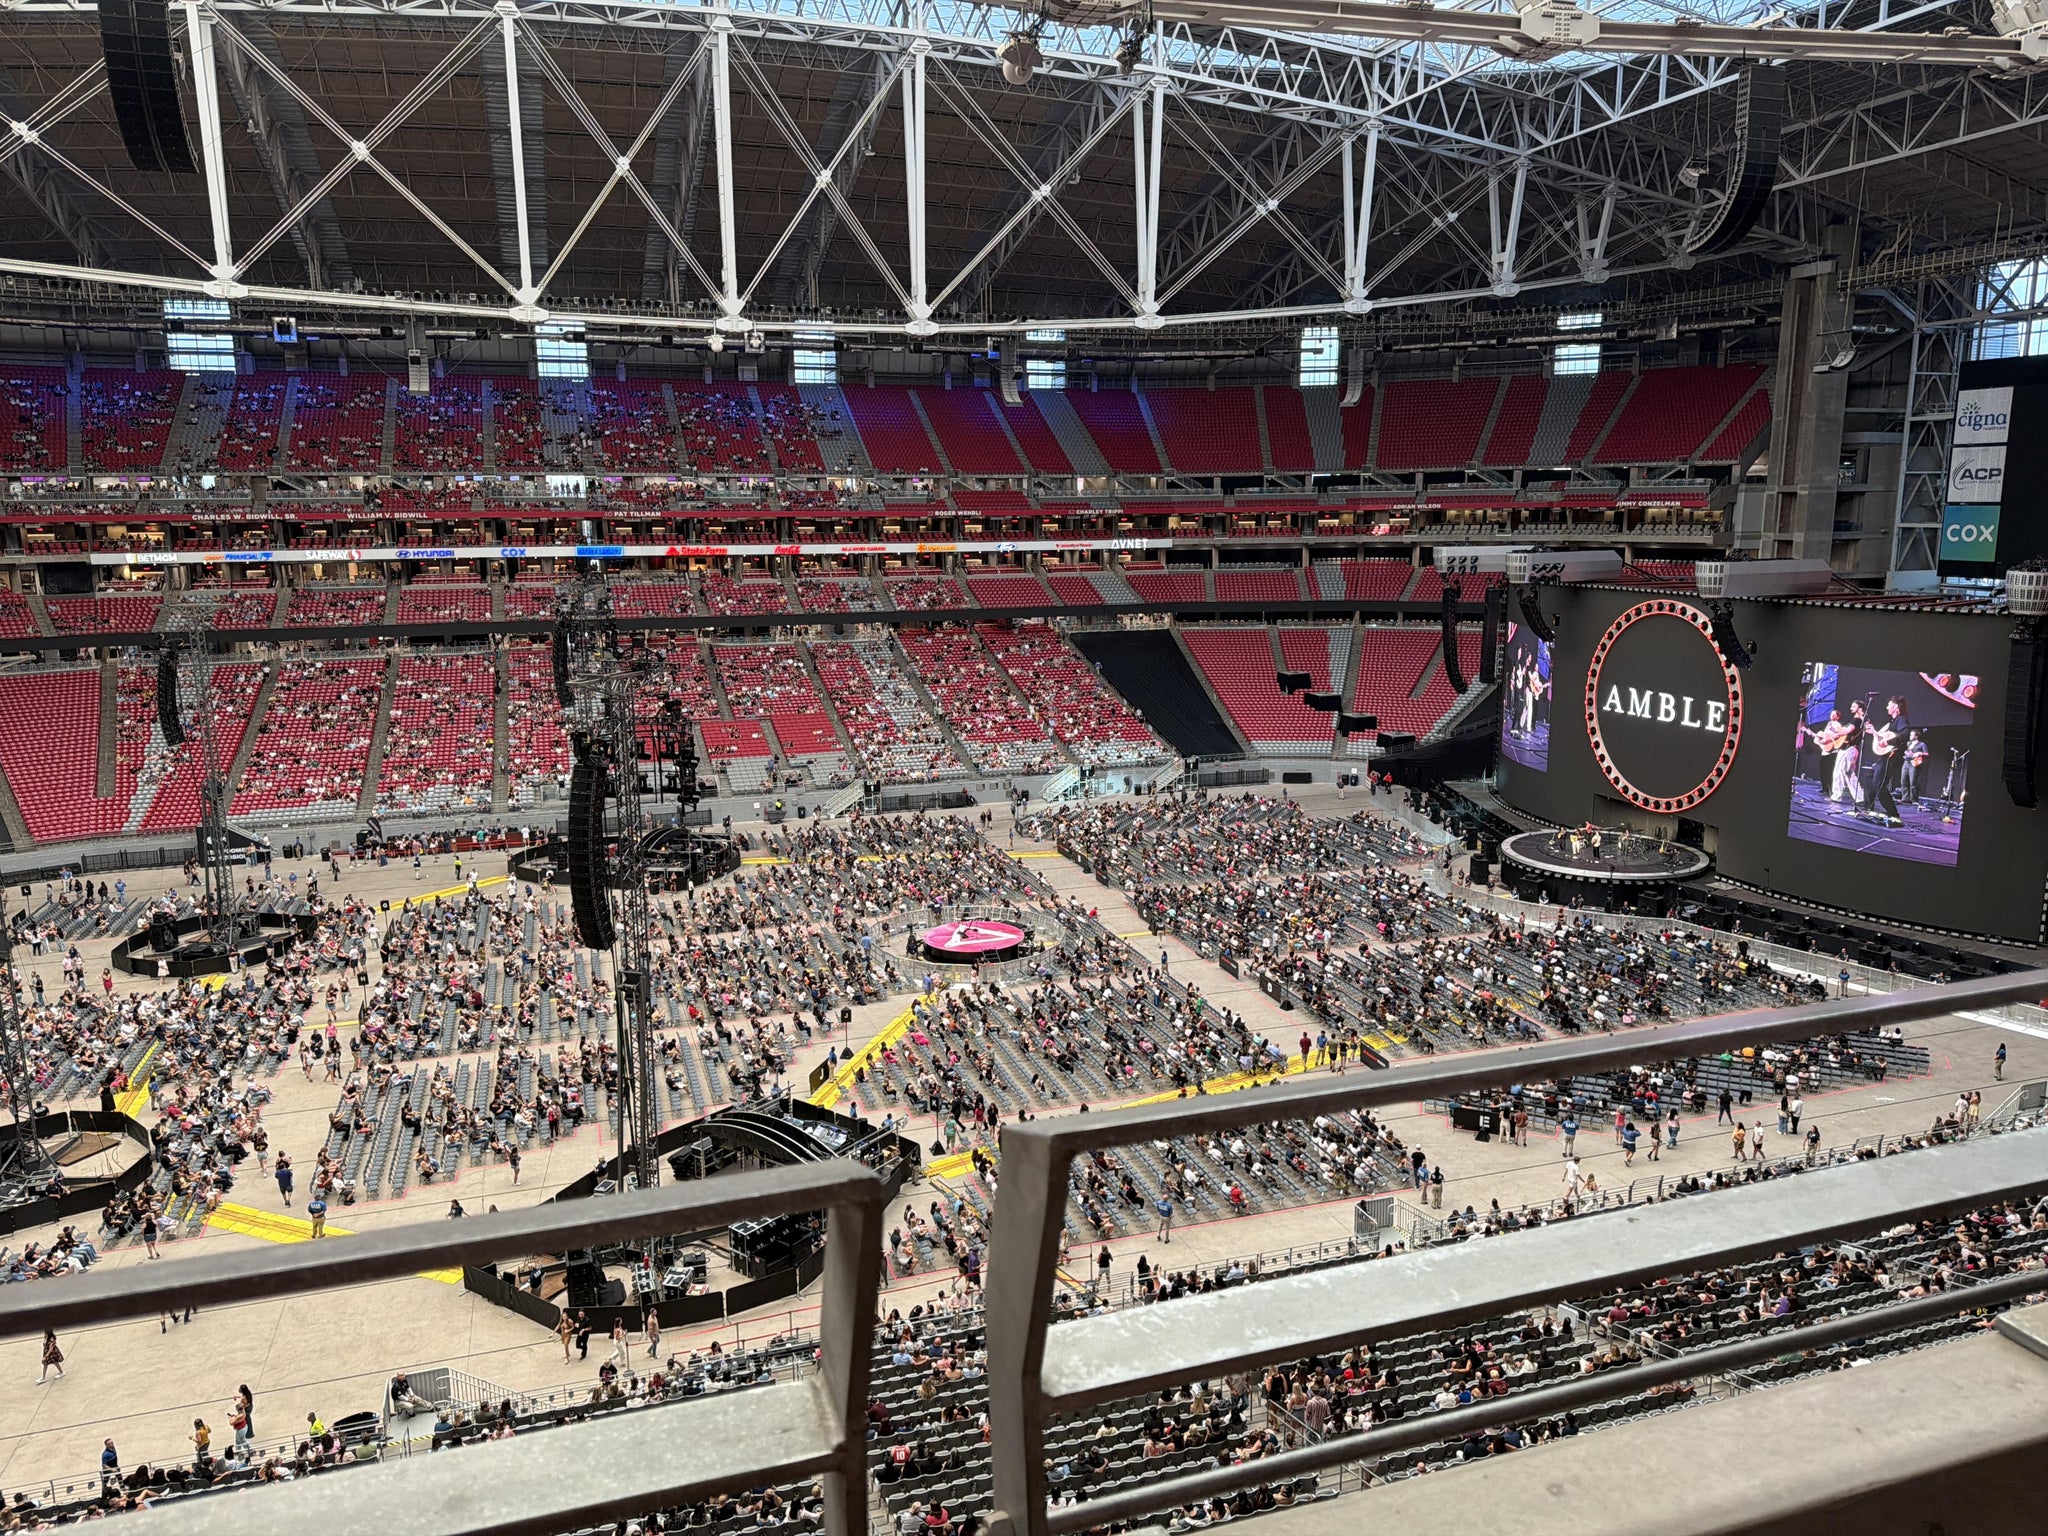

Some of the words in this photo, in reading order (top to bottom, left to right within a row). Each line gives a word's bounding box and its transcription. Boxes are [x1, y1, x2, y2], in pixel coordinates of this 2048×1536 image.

[1958, 411, 2007, 431] cigna
[1959, 468, 2002, 480] ACP
[1946, 524, 1995, 543] COX
[1111, 538, 1148, 549] AVNET
[305, 551, 349, 561] SAFEWAY
[412, 550, 455, 558] HYUNDAI
[501, 548, 527, 557] COX
[1602, 684, 1726, 733] AMBLE
[896, 1450, 906, 1460] 10
